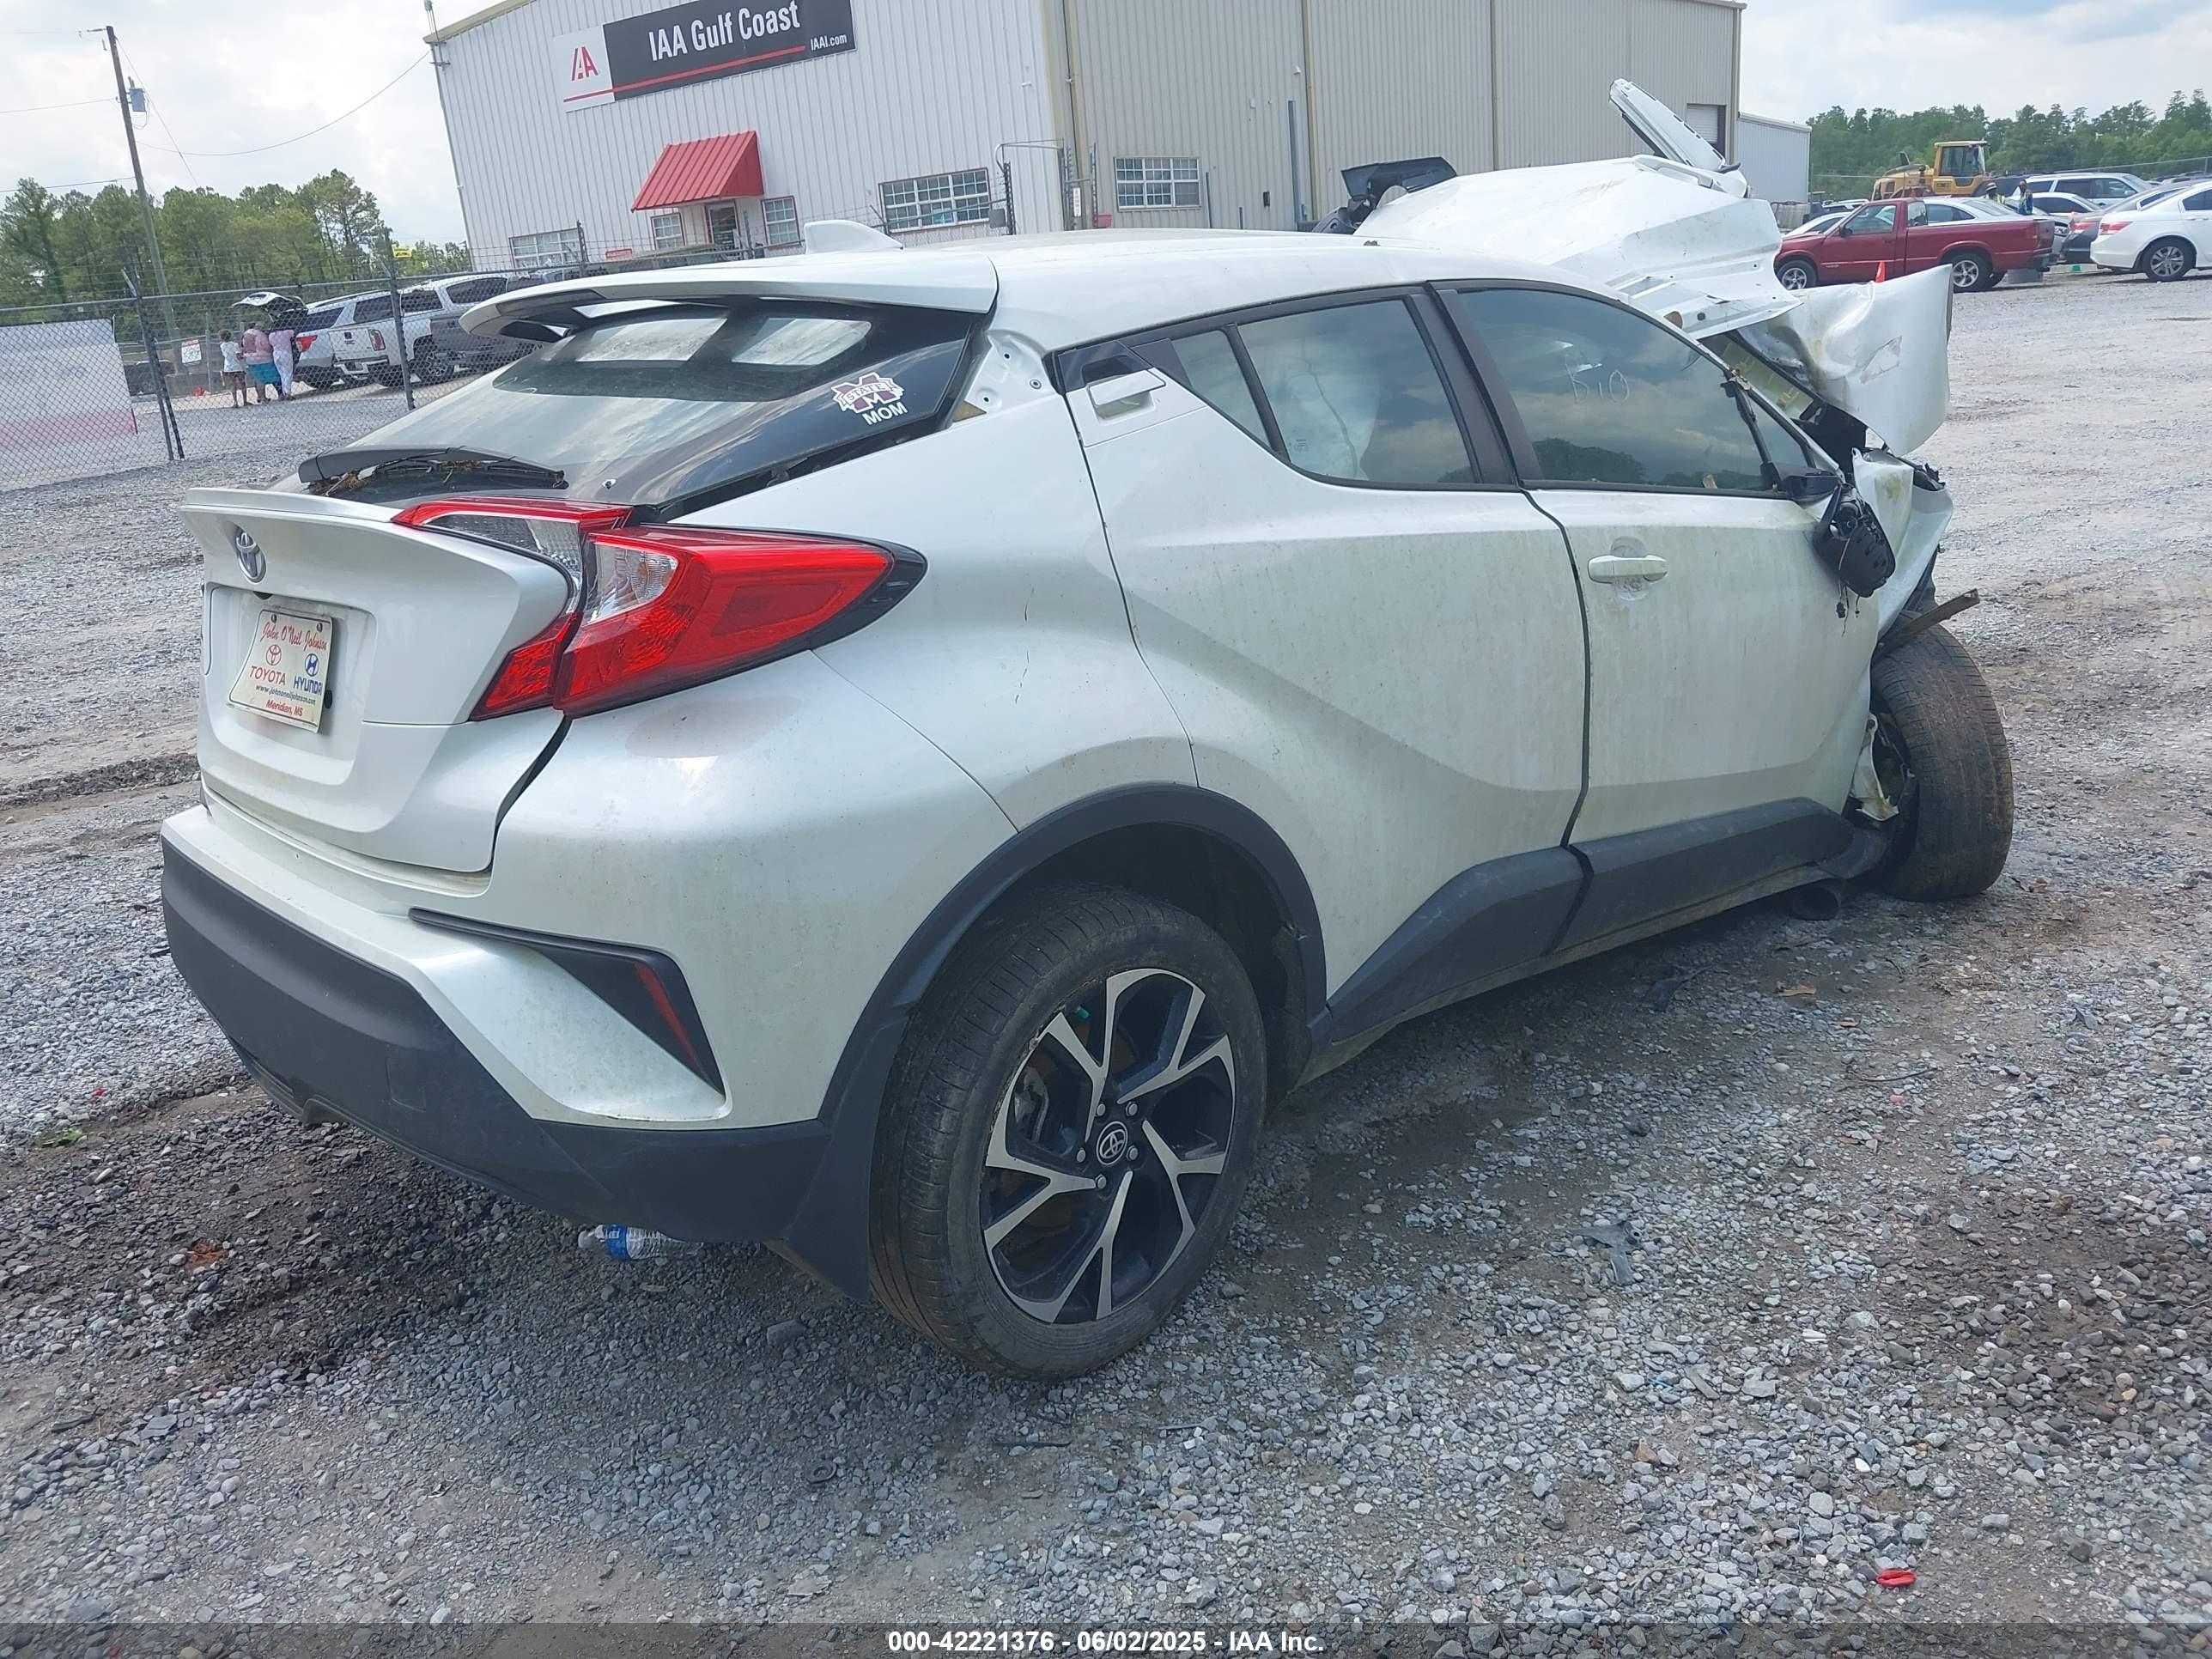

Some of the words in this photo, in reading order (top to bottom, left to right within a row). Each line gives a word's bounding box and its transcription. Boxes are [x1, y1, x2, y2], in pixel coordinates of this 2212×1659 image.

[648, 24, 688, 61] IAA
[690, 12, 733, 52] Gulf
[738, 1, 800, 40] Coast
[810, 33, 848, 51] IAAI.com
[844, 381, 887, 403] STATE
[861, 402, 908, 424] MOM
[249, 665, 286, 686] TOYOTA
[293, 706, 304, 717] MS
